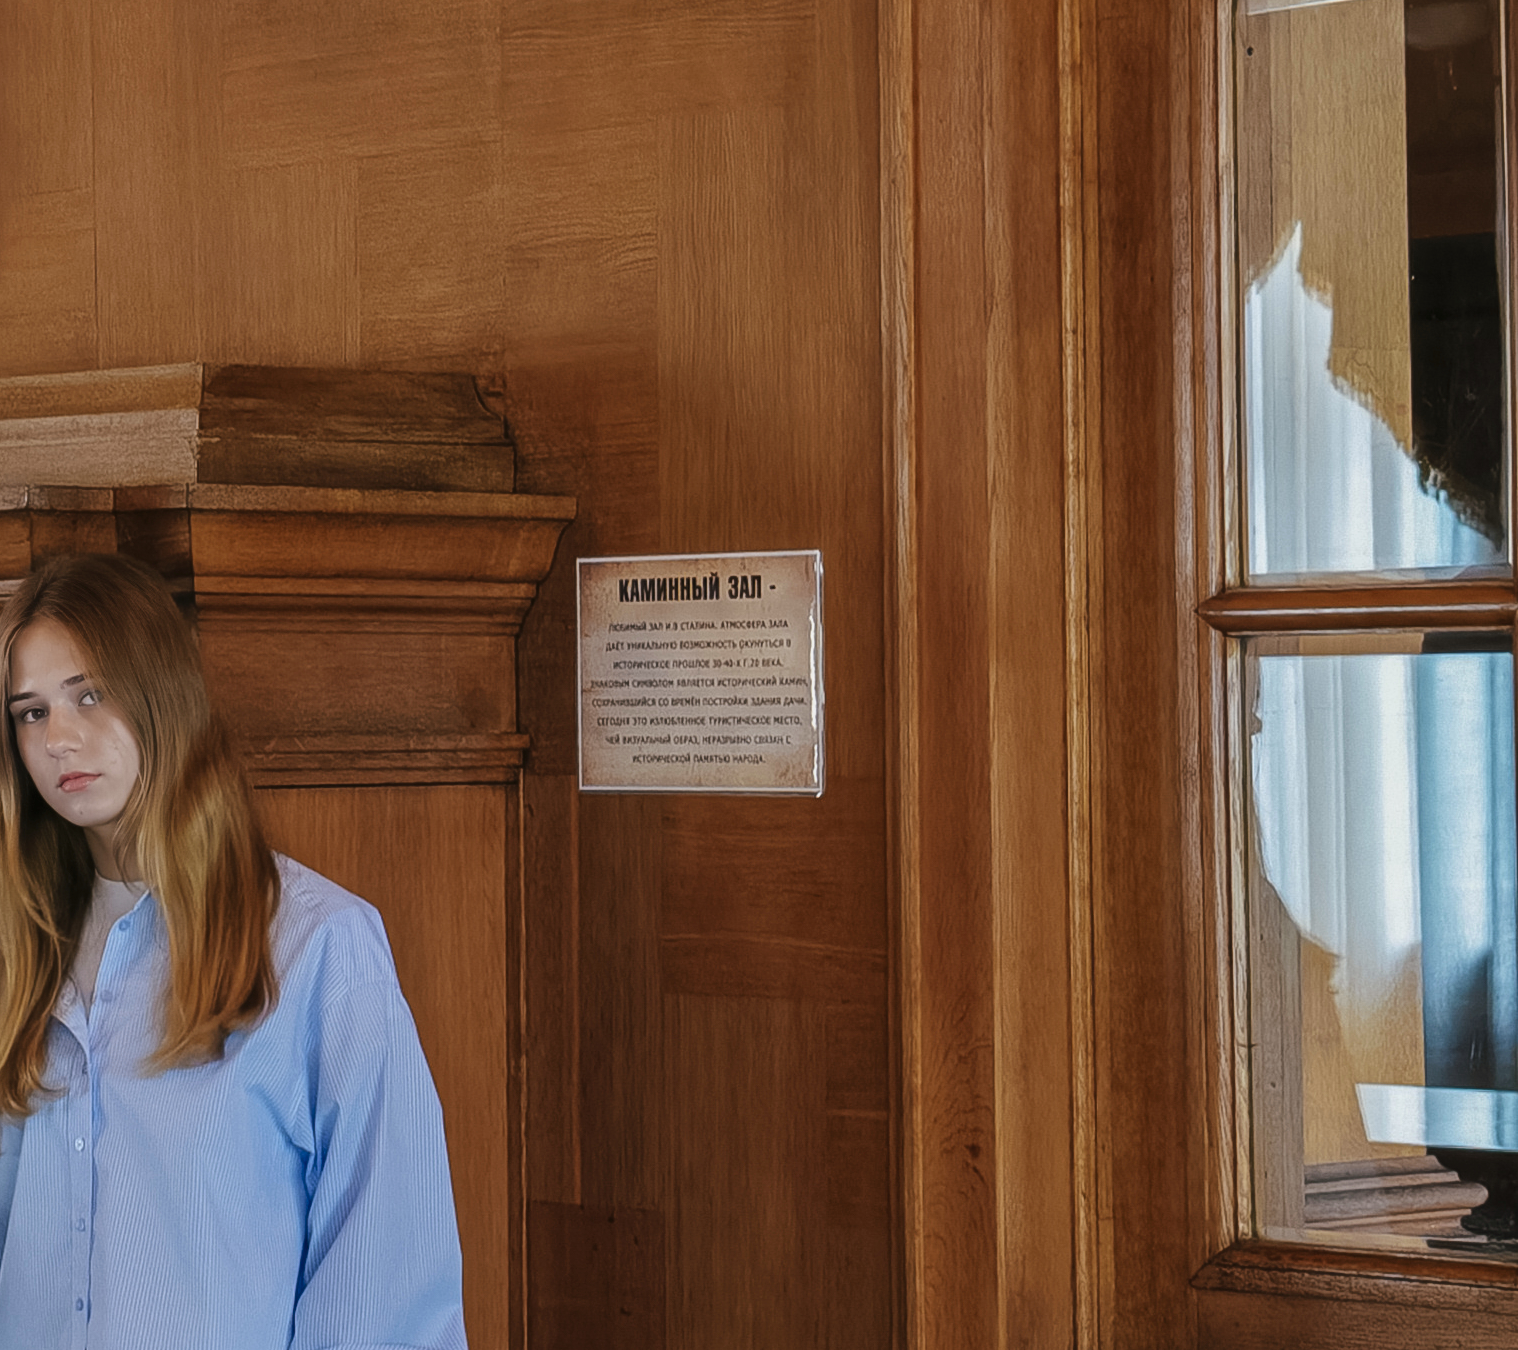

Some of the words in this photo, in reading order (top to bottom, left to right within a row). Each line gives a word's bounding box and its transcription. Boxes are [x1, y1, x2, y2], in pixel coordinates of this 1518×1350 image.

[618, 572, 720, 603] КАМИННЫЙ
[728, 575, 762, 600] ЗАЛ
[720, 620, 766, 629] АТМОСФЕРА
[680, 639, 736, 649] ВОЗМОЖНОСТЬ
[717, 675, 776, 687] ИСТОРИЧЕСКИЙ
[632, 717, 647, 726] ЭТО
